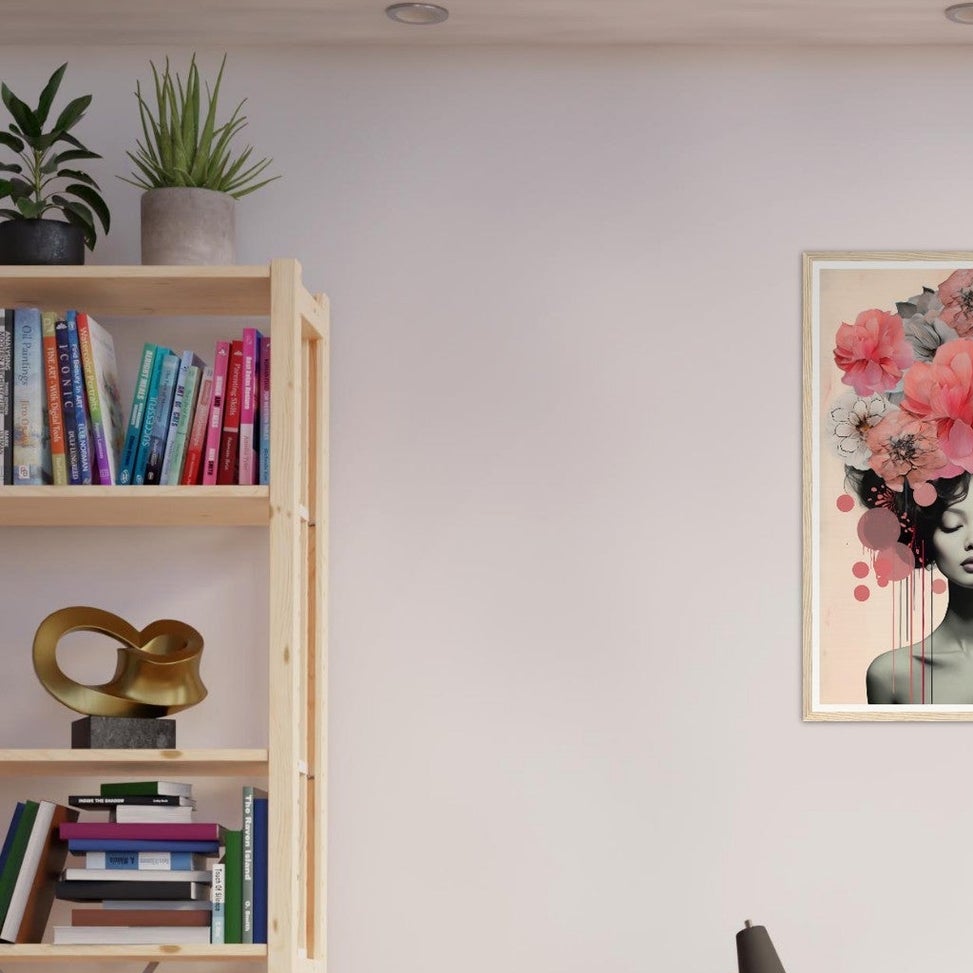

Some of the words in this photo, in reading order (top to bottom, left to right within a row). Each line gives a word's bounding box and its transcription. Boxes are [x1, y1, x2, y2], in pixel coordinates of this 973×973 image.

[21, 325, 32, 339] Oil
[47, 347, 56, 364] FINE
[71, 343, 80, 358] Find
[19, 342, 31, 385] Paintings
[48, 365, 57, 380] ART
[72, 359, 82, 383] Beauty
[80, 327, 92, 373] Watercolor
[87, 375, 99, 411] Portraits
[58, 344, 73, 408] ICONIC
[229, 363, 242, 397] Parenting
[76, 395, 84, 408] ART
[229, 397, 239, 416] Skills
[49, 402, 61, 424] Digital
[142, 396, 158, 447] SUCCESSFUL
[53, 426, 61, 442] Tools
[79, 440, 89, 472] NORMAN
[215, 868, 223, 884] Touch
